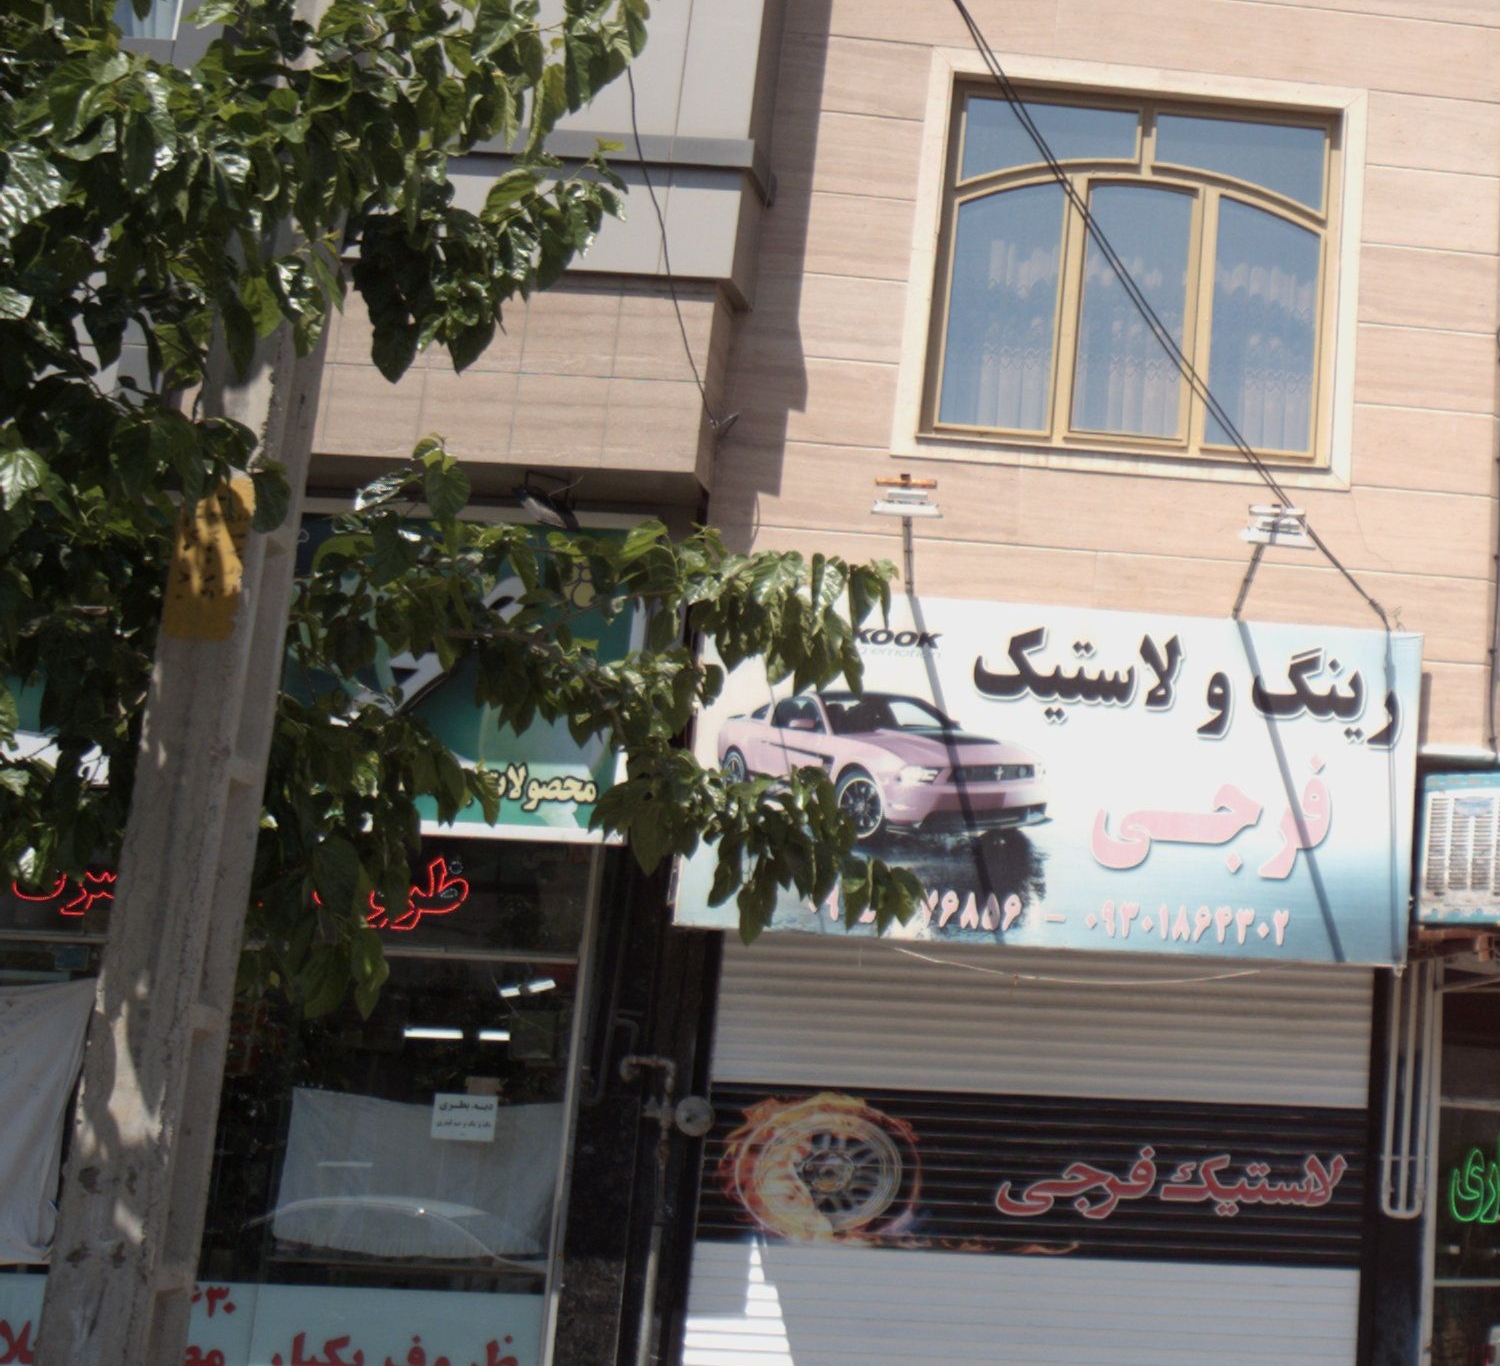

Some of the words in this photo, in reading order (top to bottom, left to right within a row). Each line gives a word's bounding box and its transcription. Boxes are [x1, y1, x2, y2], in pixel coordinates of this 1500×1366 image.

[973, 626, 1183, 722] لاستیک
[1196, 671, 1233, 739] و
[1251, 647, 1401, 748] رینگ
[1091, 754, 1331, 880] فرجی
[1087, 899, 1290, 947] ۰۹۳۰۱۸۶۴۳۰۲
[995, 1146, 1157, 1219] فرجی
[1160, 1154, 1347, 1217] لاستیک
